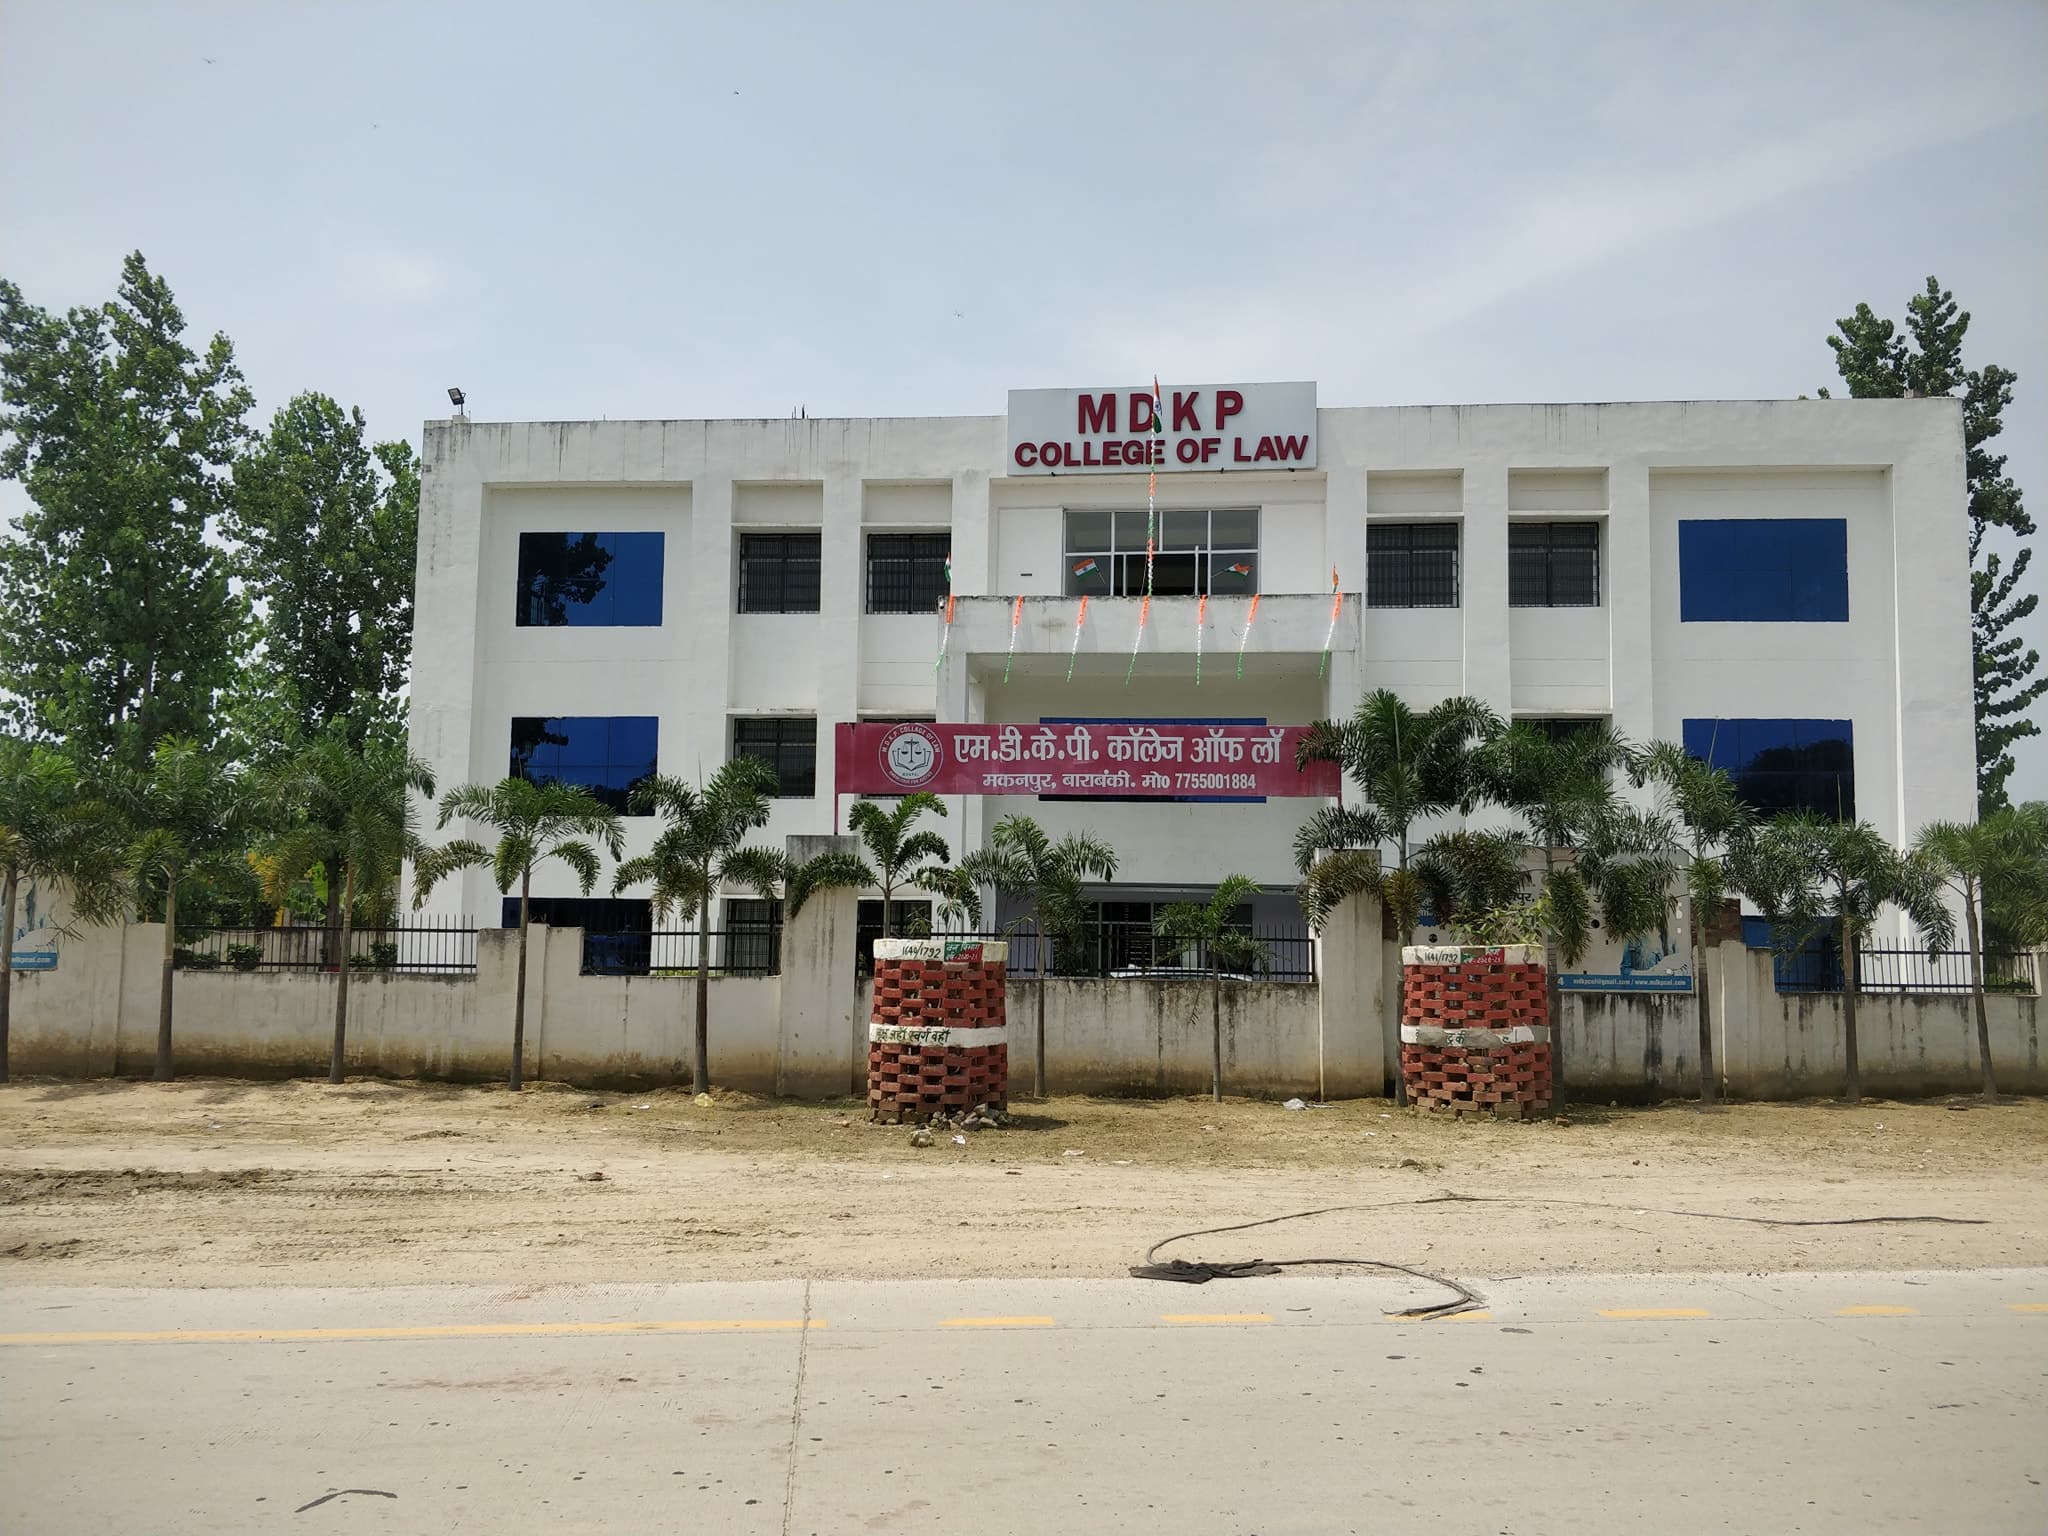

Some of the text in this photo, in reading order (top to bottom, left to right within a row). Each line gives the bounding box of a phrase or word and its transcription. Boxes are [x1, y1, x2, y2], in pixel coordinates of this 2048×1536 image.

[1014, 435, 1310, 467] COLLEGE OF LAW
[954, 726, 1285, 763] एम.डी.के.पी. कॉलेज ऑफ लॉ
[983, 773, 1057, 792] मकनपुर,
[1063, 769, 1136, 788] बाराबंकी.
[1175, 773, 1256, 789] 7755001884
